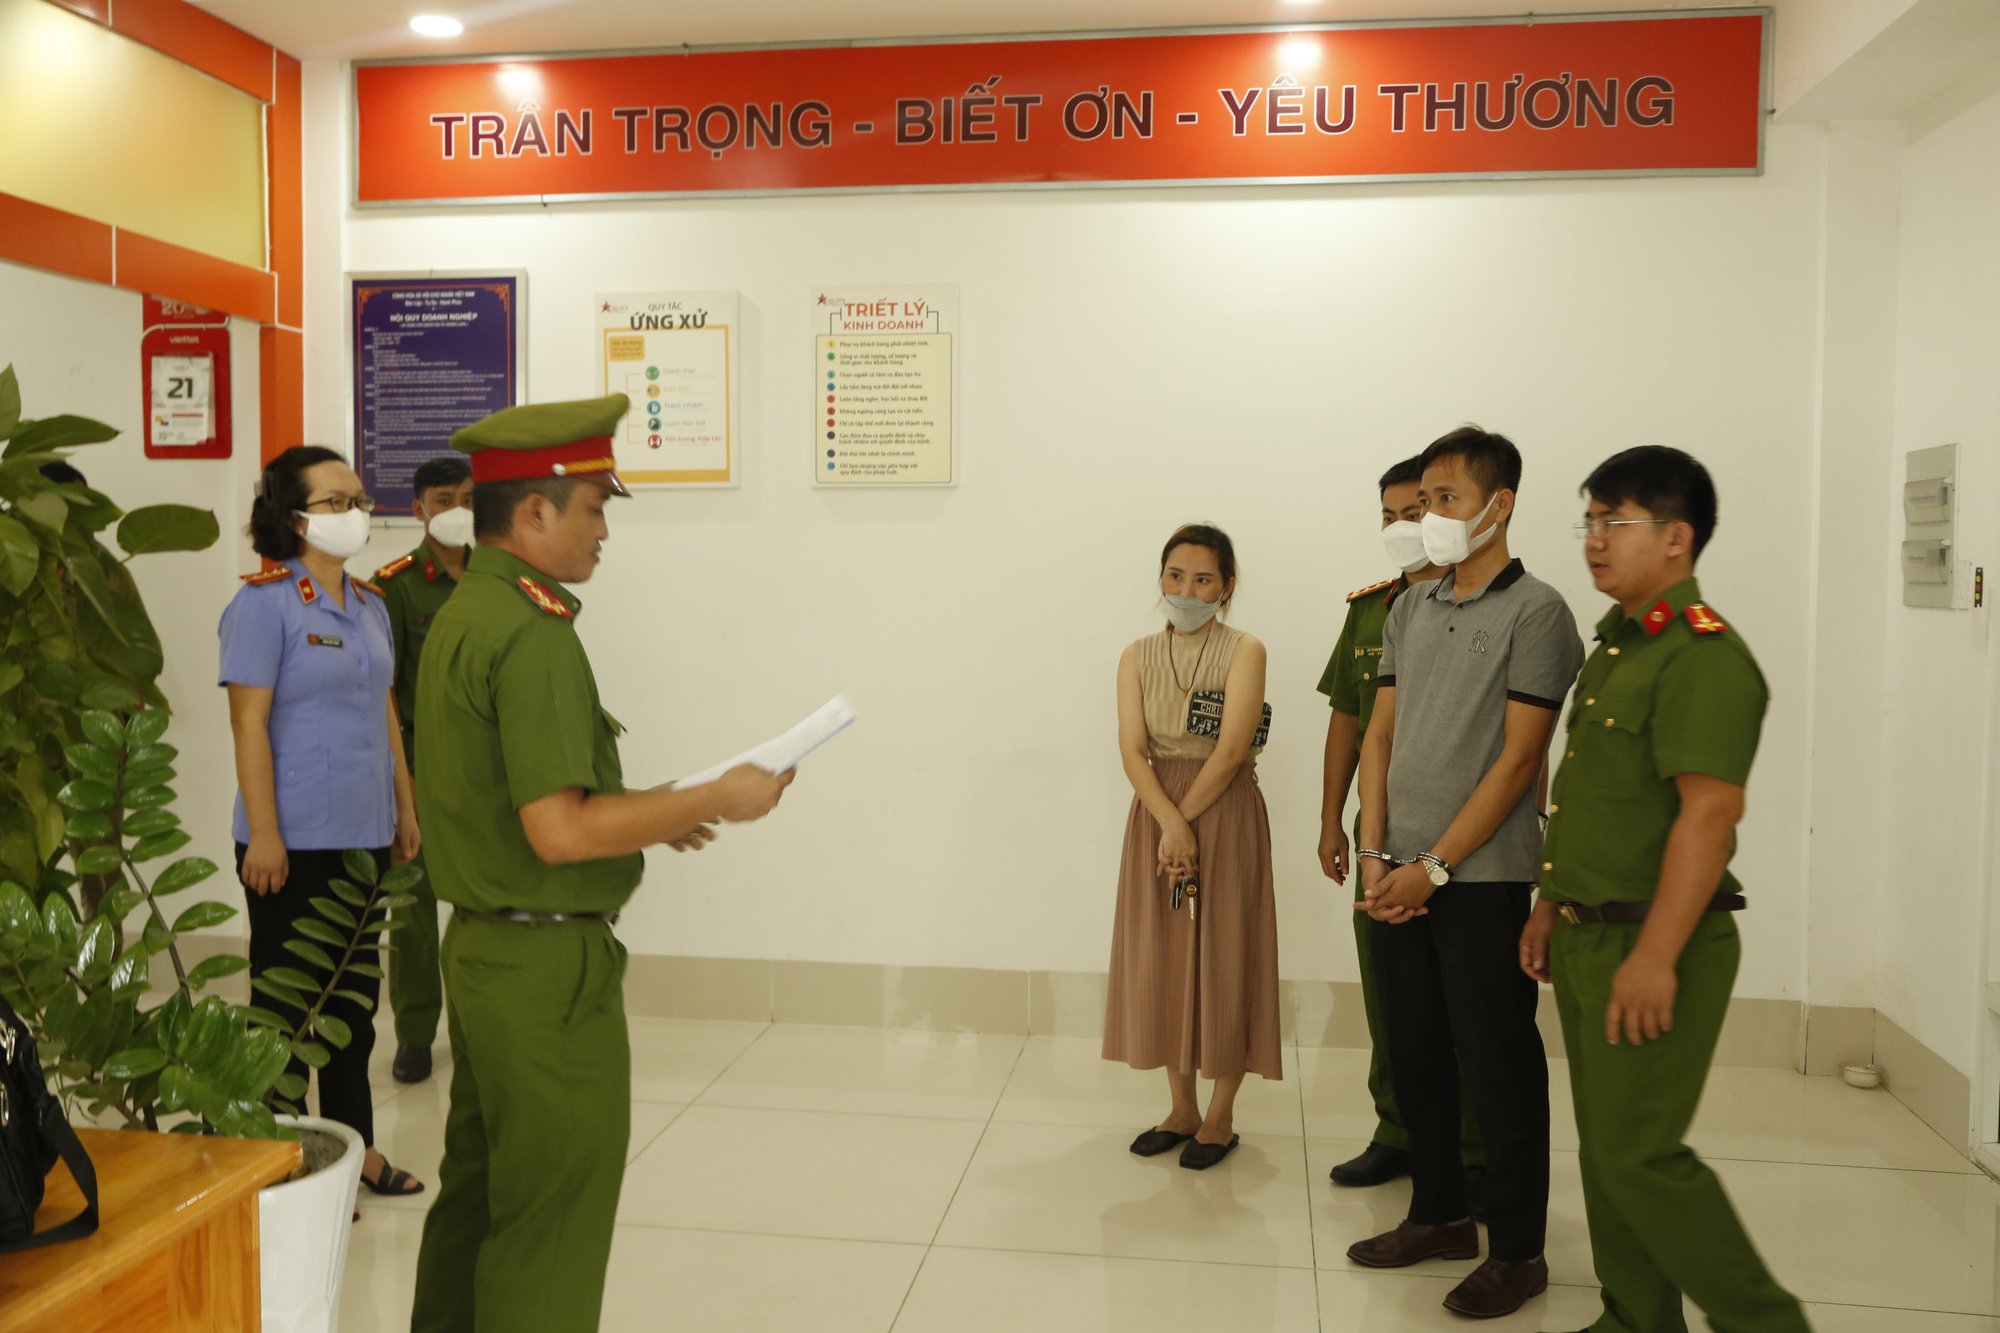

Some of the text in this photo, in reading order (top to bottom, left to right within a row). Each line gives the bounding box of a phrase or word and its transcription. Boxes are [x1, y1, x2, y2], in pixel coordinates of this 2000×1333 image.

[430, 71, 1675, 160] TRÂN TRỌNG - BIẾT ƠN - YÊU THƯƠNG
[648, 301, 682, 312] QUY TẮC
[844, 298, 898, 317] TRIẾT
[904, 298, 926, 316] LÝ
[630, 308, 708, 330] ỨNG XỬ
[844, 320, 924, 330] KINH DOANH
[170, 336, 199, 344] viettel
[167, 377, 193, 398] 21
